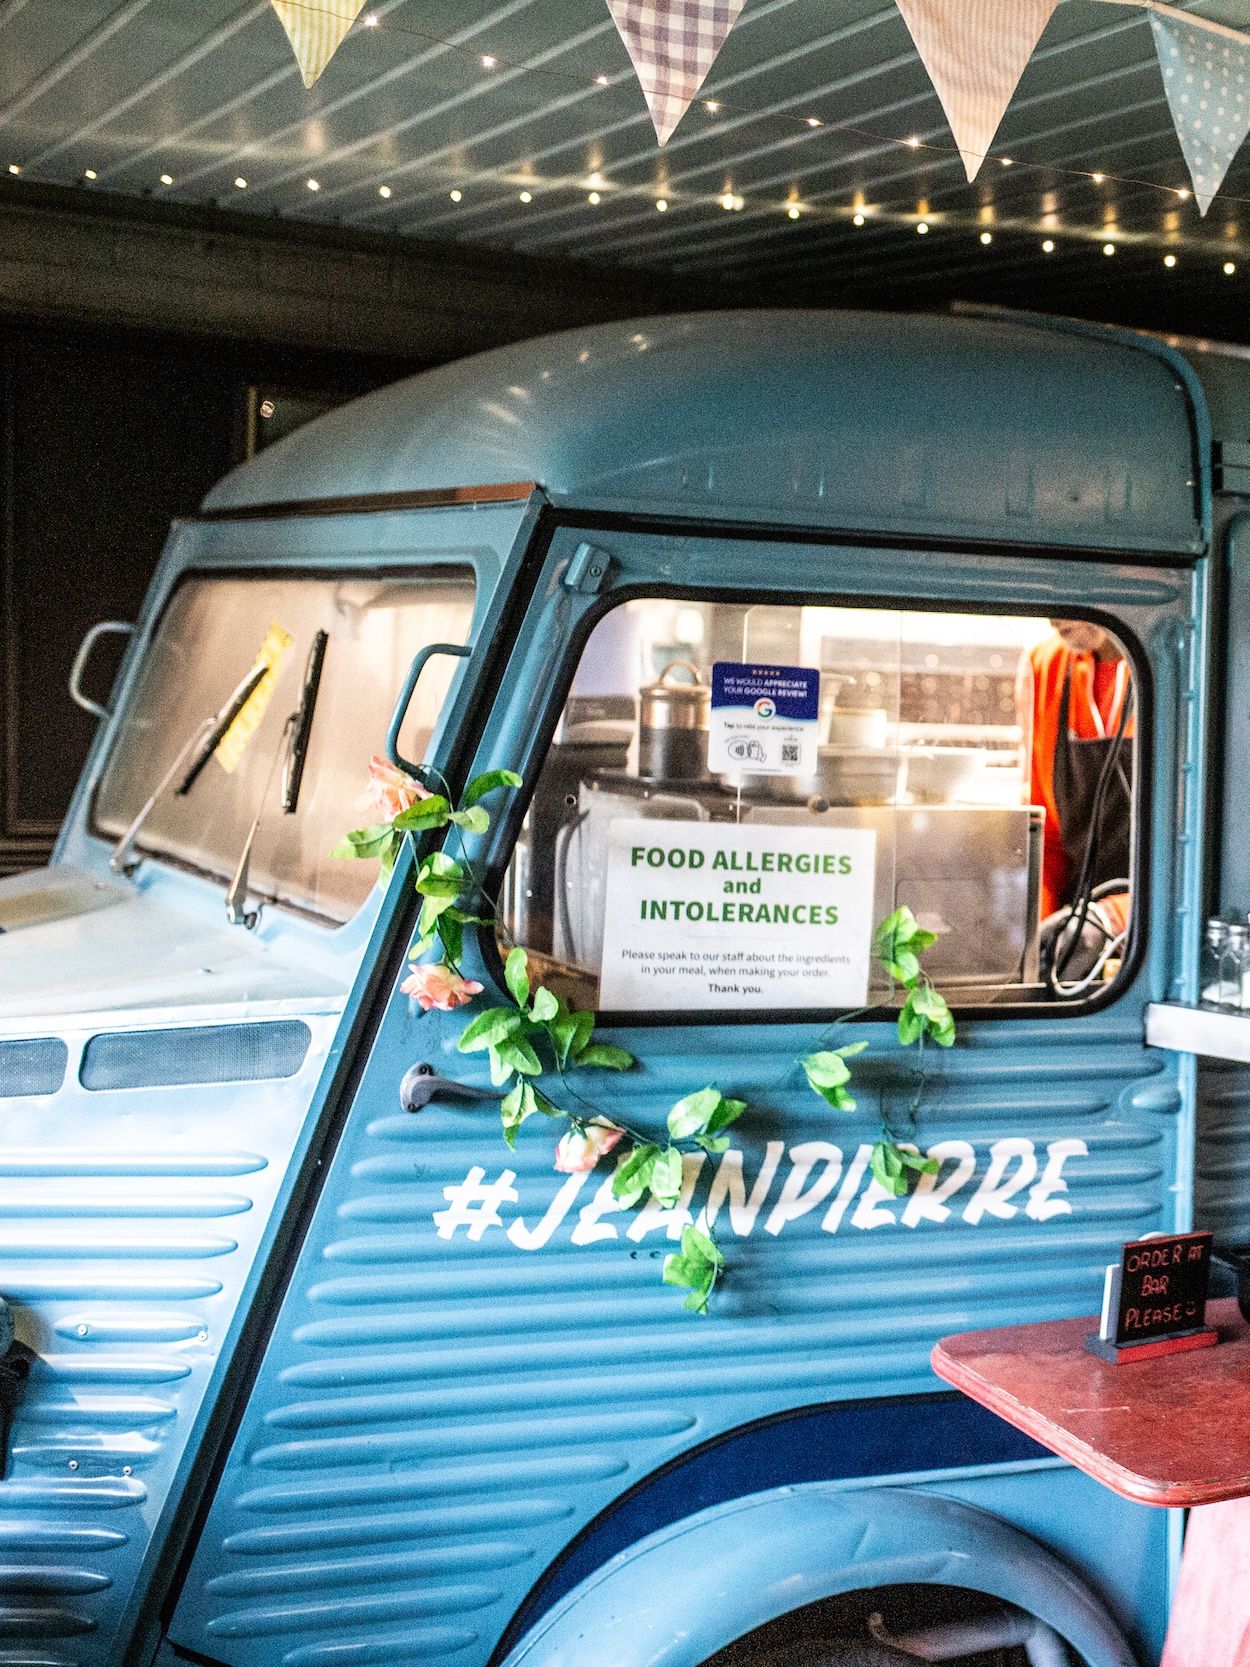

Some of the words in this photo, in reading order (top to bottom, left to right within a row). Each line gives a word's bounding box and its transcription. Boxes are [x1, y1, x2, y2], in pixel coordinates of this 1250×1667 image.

[723, 677, 735, 685] WE
[736, 677, 763, 686] WOULD
[763, 679, 808, 689] APPRECIATE
[723, 686, 744, 694] YOUR
[744, 686, 777, 697] GOOGLE
[777, 688, 808, 698] REVIEW!
[631, 846, 705, 869] FOOD
[712, 850, 852, 875] ALLERGIES
[723, 877, 762, 894] and
[640, 899, 839, 925] INTOLERANCES
[621, 949, 655, 960] Please
[657, 950, 688, 962] speak
[690, 952, 700, 961] to
[702, 953, 719, 961] our
[722, 951, 744, 962] staff
[746, 953, 776, 963] about
[777, 954, 794, 963] the
[795, 954, 851, 966] ingredients
[641, 964, 651, 975] in
[653, 966, 676, 977] your
[678, 965, 707, 977] meal,
[708, 966, 736, 976] when
[738, 967, 776, 979] making
[777, 969, 800, 979] your
[801, 968, 831, 978] order.
[708, 983, 740, 994] Thank
[742, 985, 764, 995] you.
[1126, 1244, 1184, 1273] ORDER
[1187, 1244, 1205, 1263] AT
[1124, 1302, 1183, 1330] PLEASE
